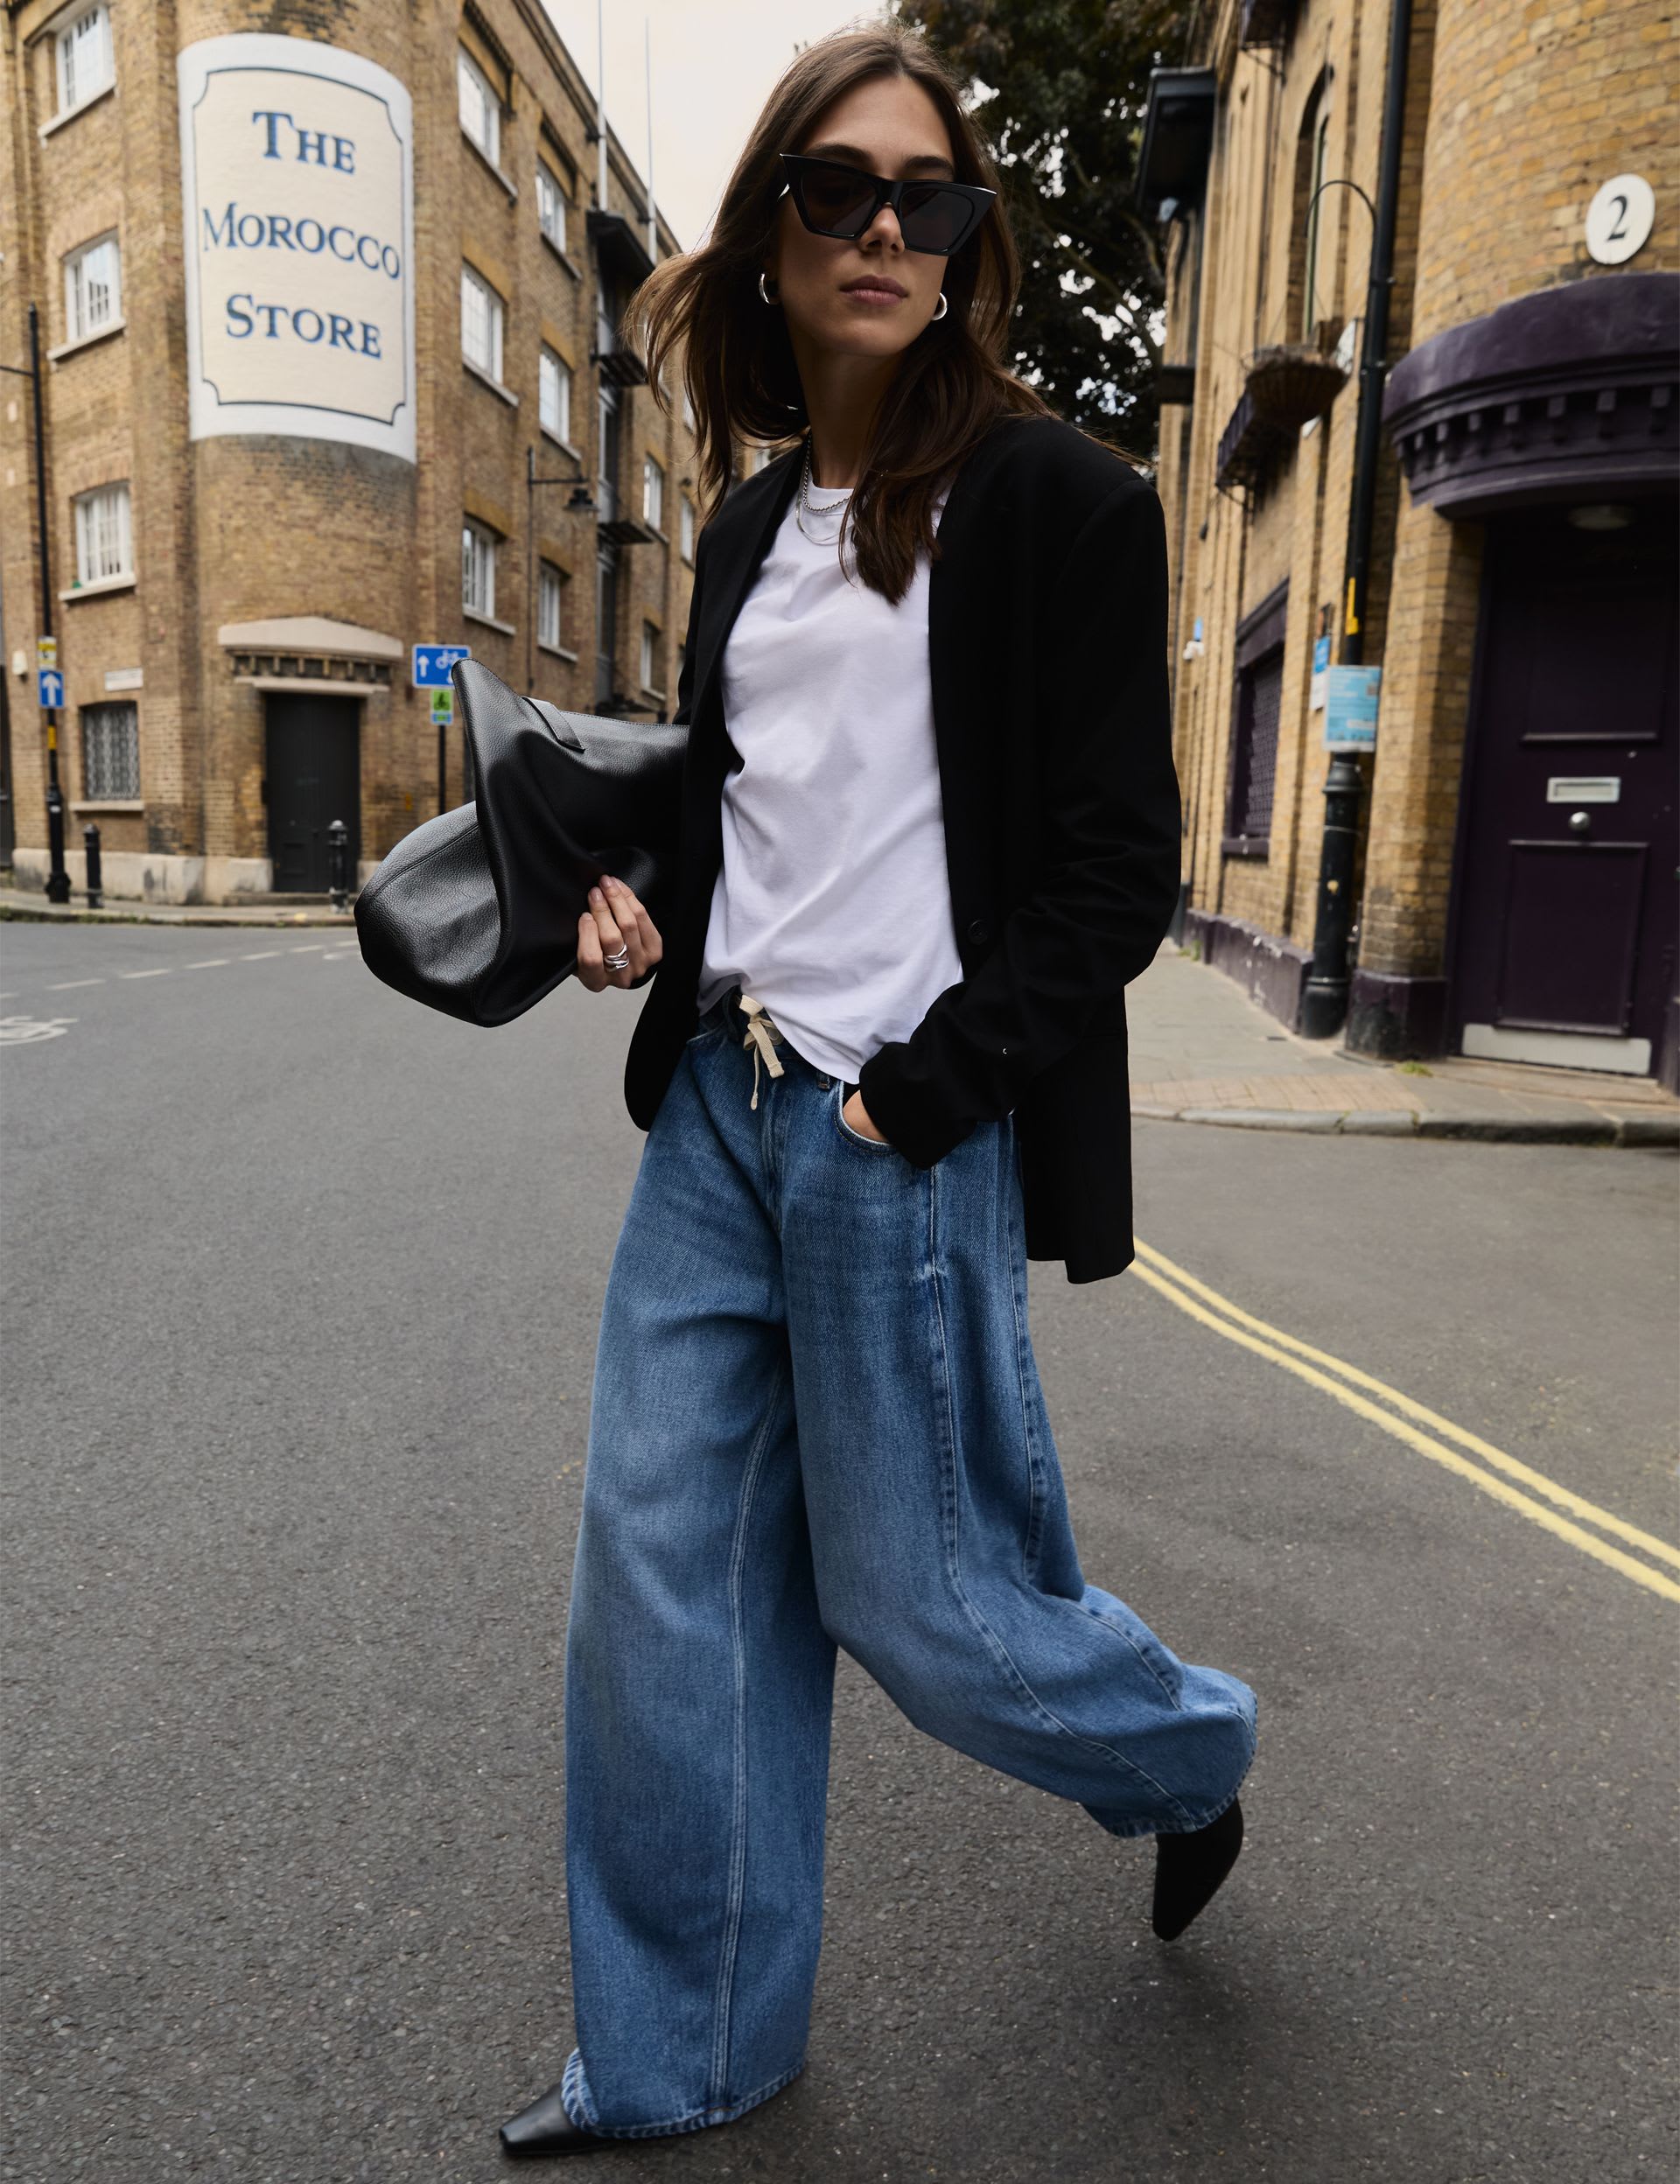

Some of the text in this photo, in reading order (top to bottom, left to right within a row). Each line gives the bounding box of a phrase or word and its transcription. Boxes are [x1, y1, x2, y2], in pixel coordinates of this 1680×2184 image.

[252, 111, 355, 174] THE
[203, 202, 400, 280] MOROCCO
[1606, 195, 1628, 242] 2
[226, 293, 381, 360] STORE
